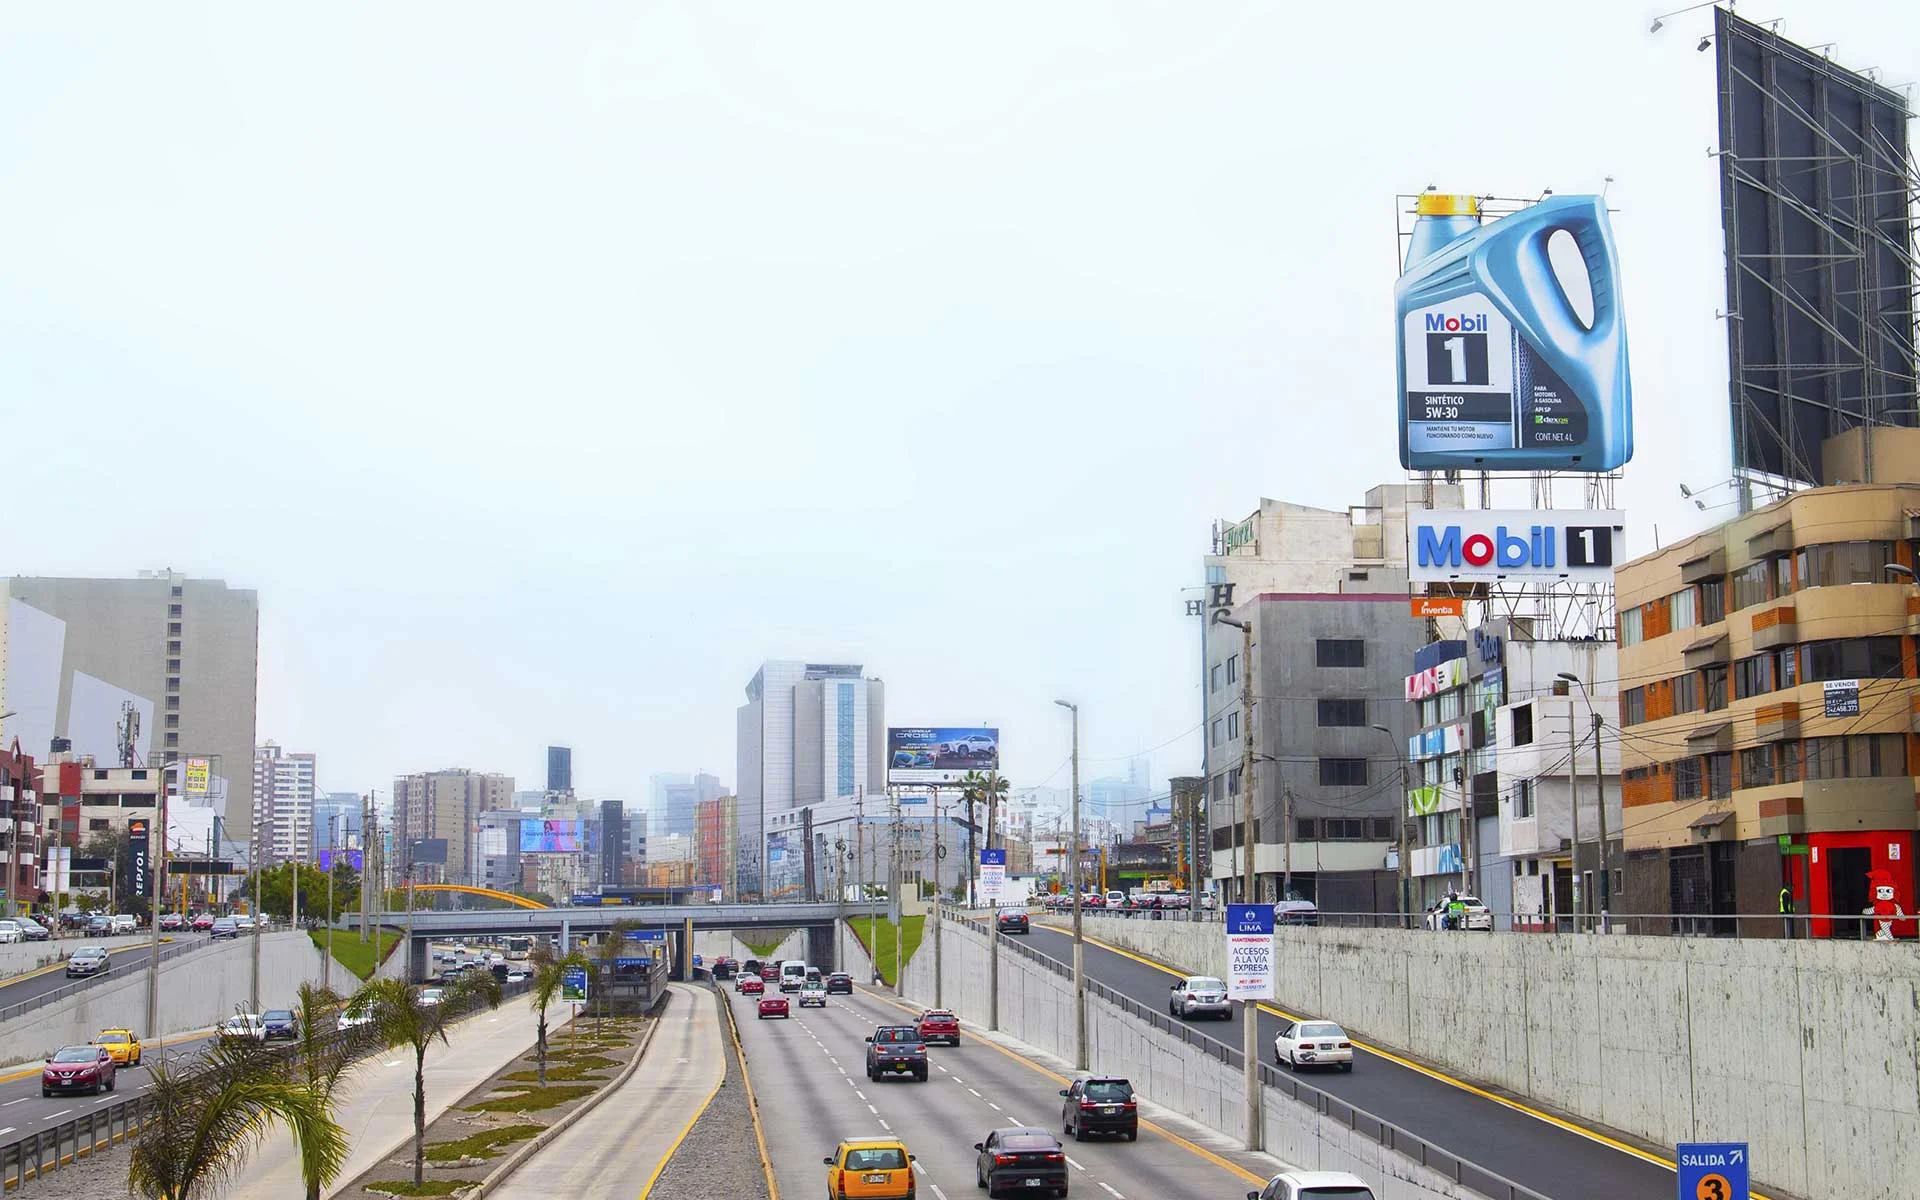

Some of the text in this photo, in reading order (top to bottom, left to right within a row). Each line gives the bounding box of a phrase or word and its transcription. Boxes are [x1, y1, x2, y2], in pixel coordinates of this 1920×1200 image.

[1425, 313, 1487, 332] Mobil
[1443, 336, 1467, 383] 1
[1425, 394, 1464, 405] SINTÉTICO
[1426, 407, 1459, 419] 5W-30
[1543, 416, 1569, 424] dexos
[1418, 525, 1595, 567] Mobil 1
[1421, 602, 1453, 615] inventa
[135, 850, 144, 896] REPSOL
[1233, 948, 1270, 956] ACCESOS
[1253, 955, 1268, 963] VÍA
[1233, 964, 1269, 972] EXPRESA
[1682, 1154, 1726, 1166] SALIDA
[1703, 1179, 1724, 1200] 3
